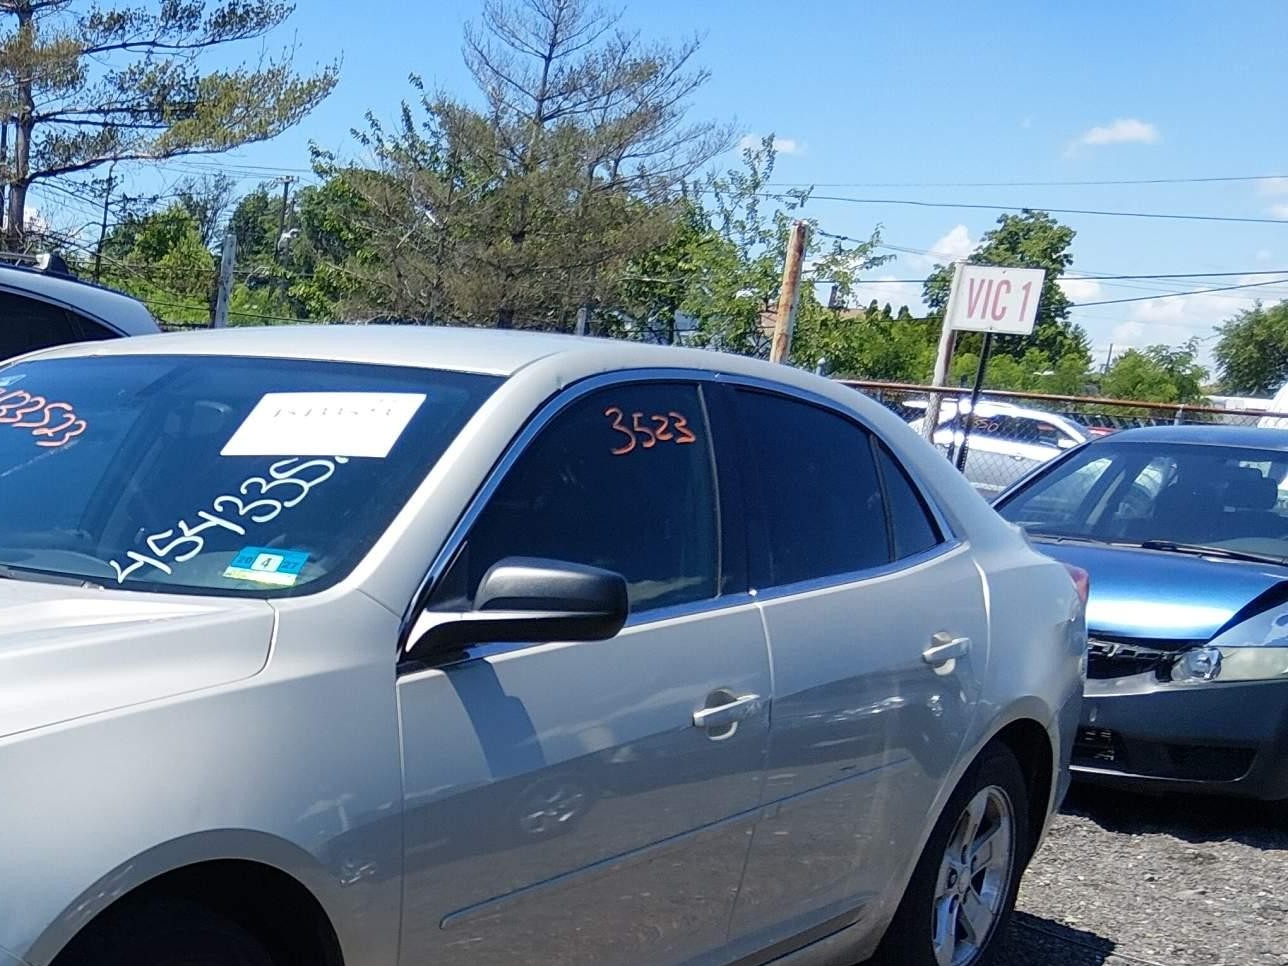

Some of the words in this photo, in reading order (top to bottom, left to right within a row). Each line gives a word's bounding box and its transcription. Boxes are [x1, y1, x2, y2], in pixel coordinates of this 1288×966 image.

[967, 278, 1011, 321] VIC
[1018, 281, 1032, 322] 1
[605, 407, 696, 455] 3523
